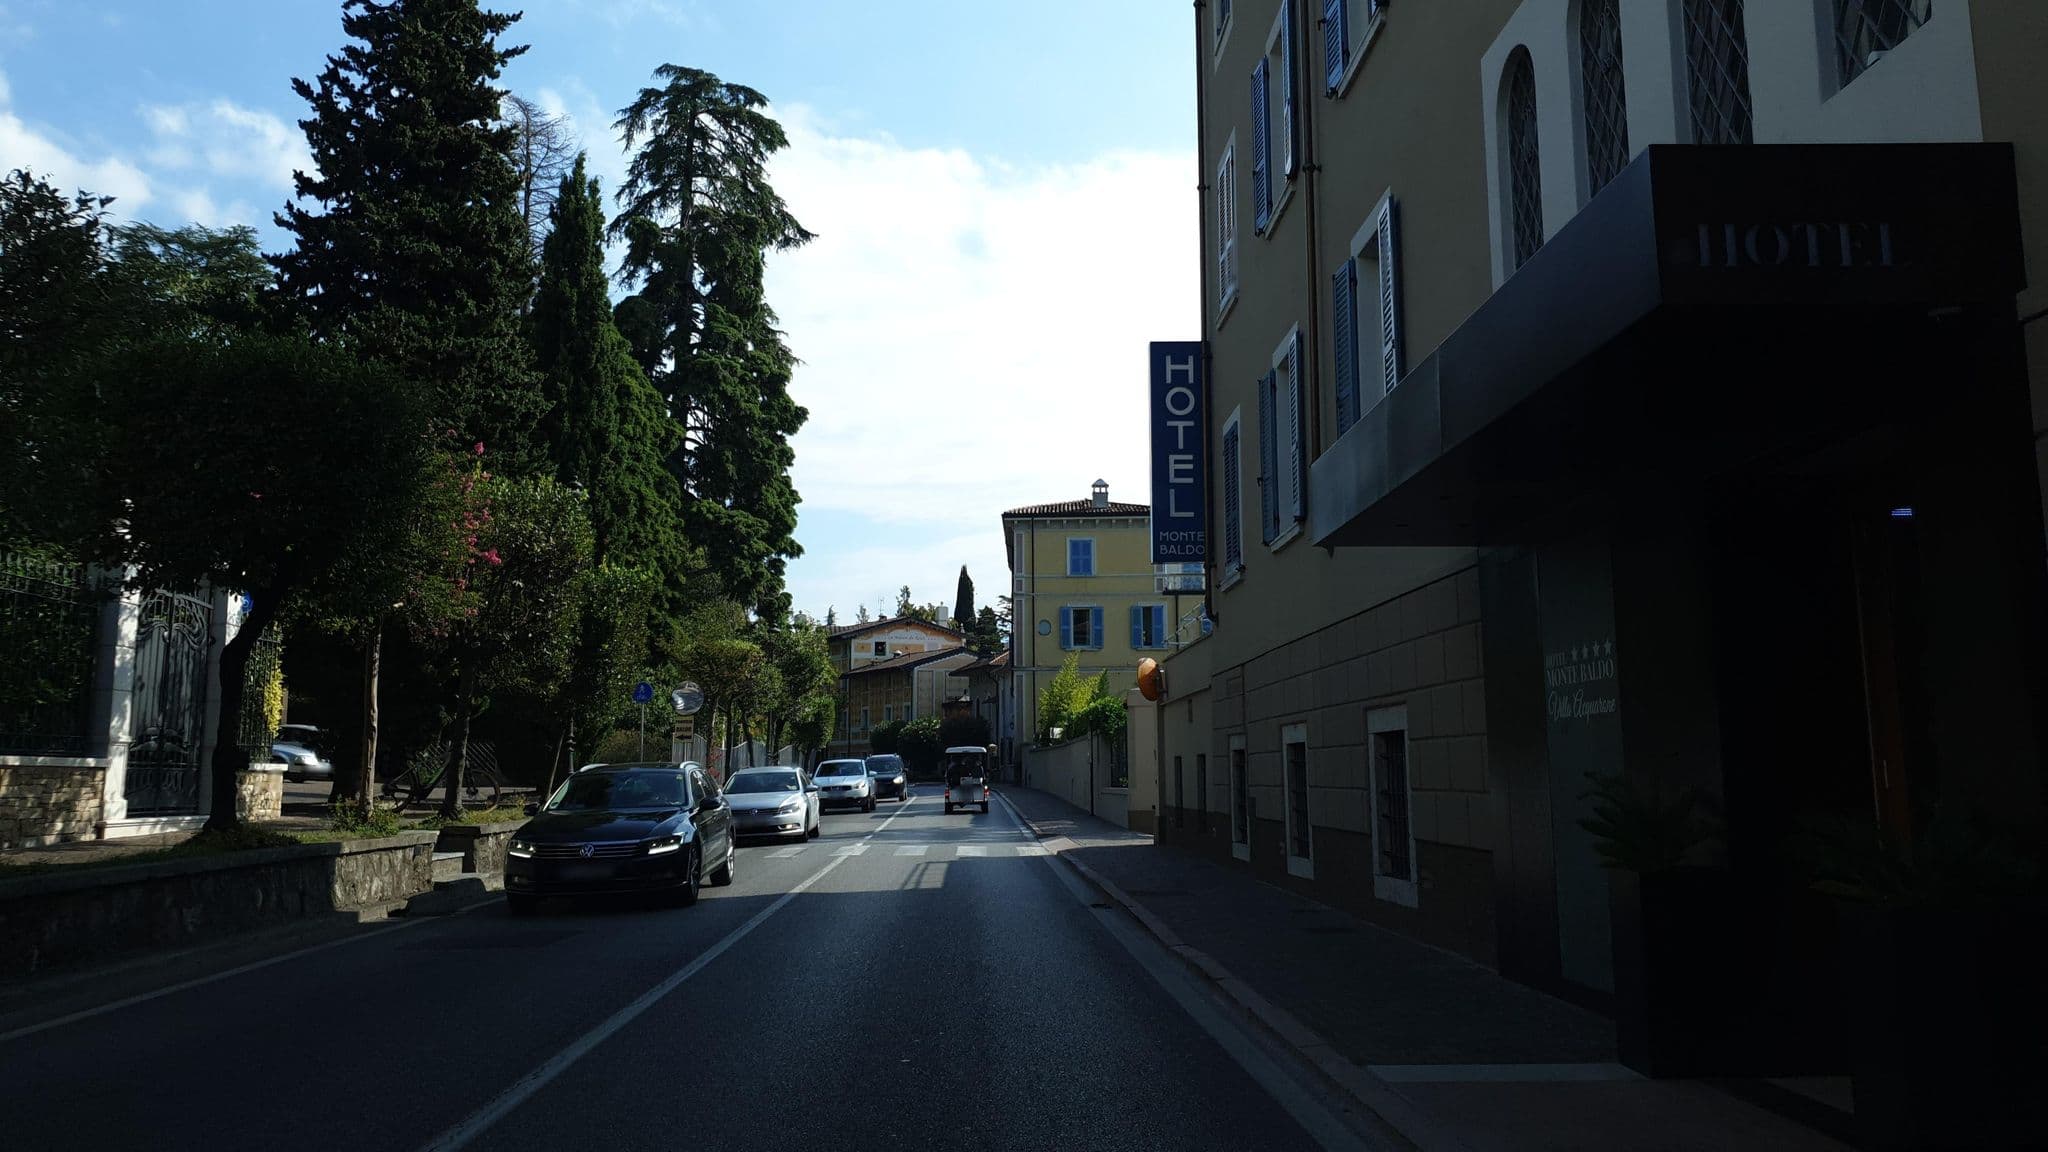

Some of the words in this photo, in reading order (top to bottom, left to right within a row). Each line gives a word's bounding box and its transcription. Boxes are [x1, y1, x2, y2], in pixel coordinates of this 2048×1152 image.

[1697, 220, 1913, 268] HOTEL
[1165, 355, 1195, 518] HOTEL
[1159, 530, 1205, 542] MONTE
[1159, 544, 1206, 555] BALDO
[1546, 664, 1578, 688] MONTE
[1579, 658, 1614, 682] BALDO
